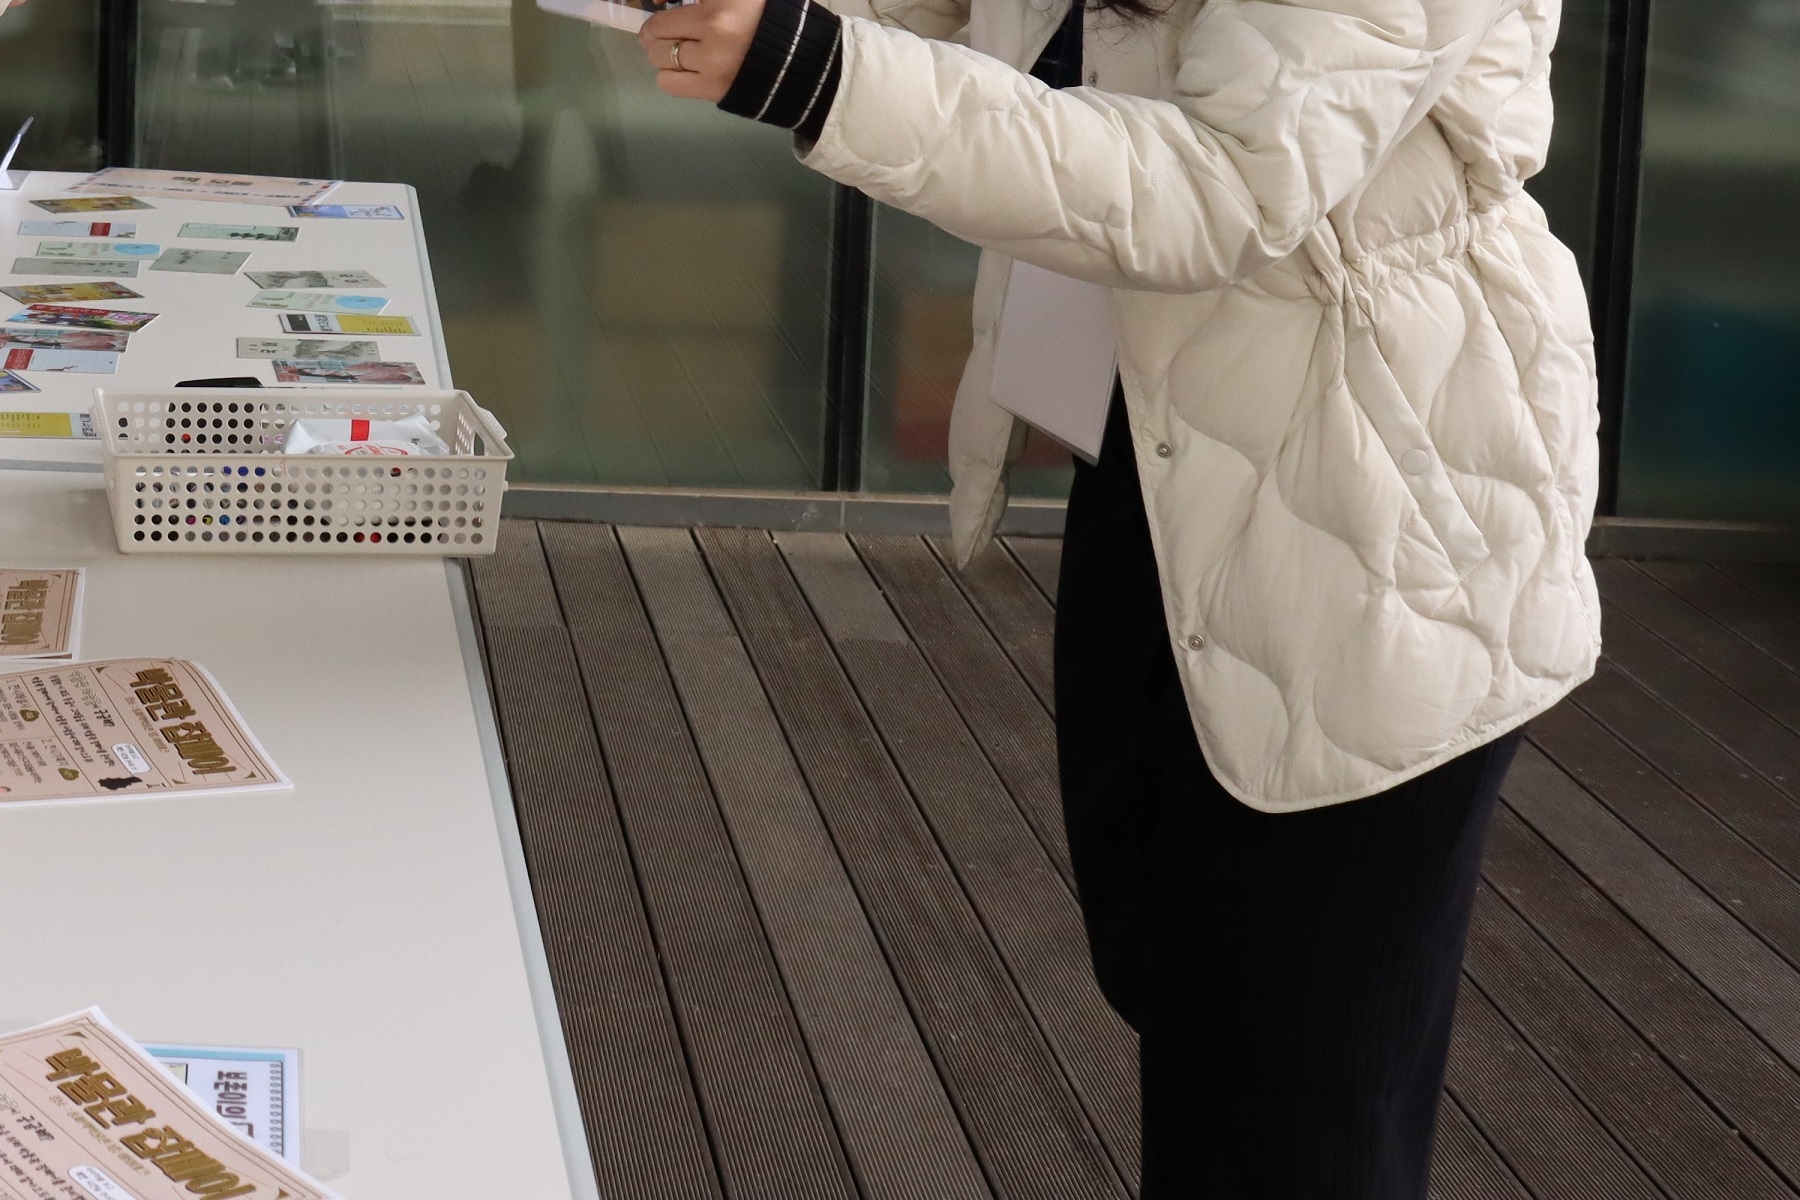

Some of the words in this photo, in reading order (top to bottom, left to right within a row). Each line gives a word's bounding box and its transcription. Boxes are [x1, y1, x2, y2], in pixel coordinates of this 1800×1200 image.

[134, 669, 192, 720] 박물관
[48, 1050, 152, 1126] 박물관
[124, 1128, 250, 1200] 잡페어
